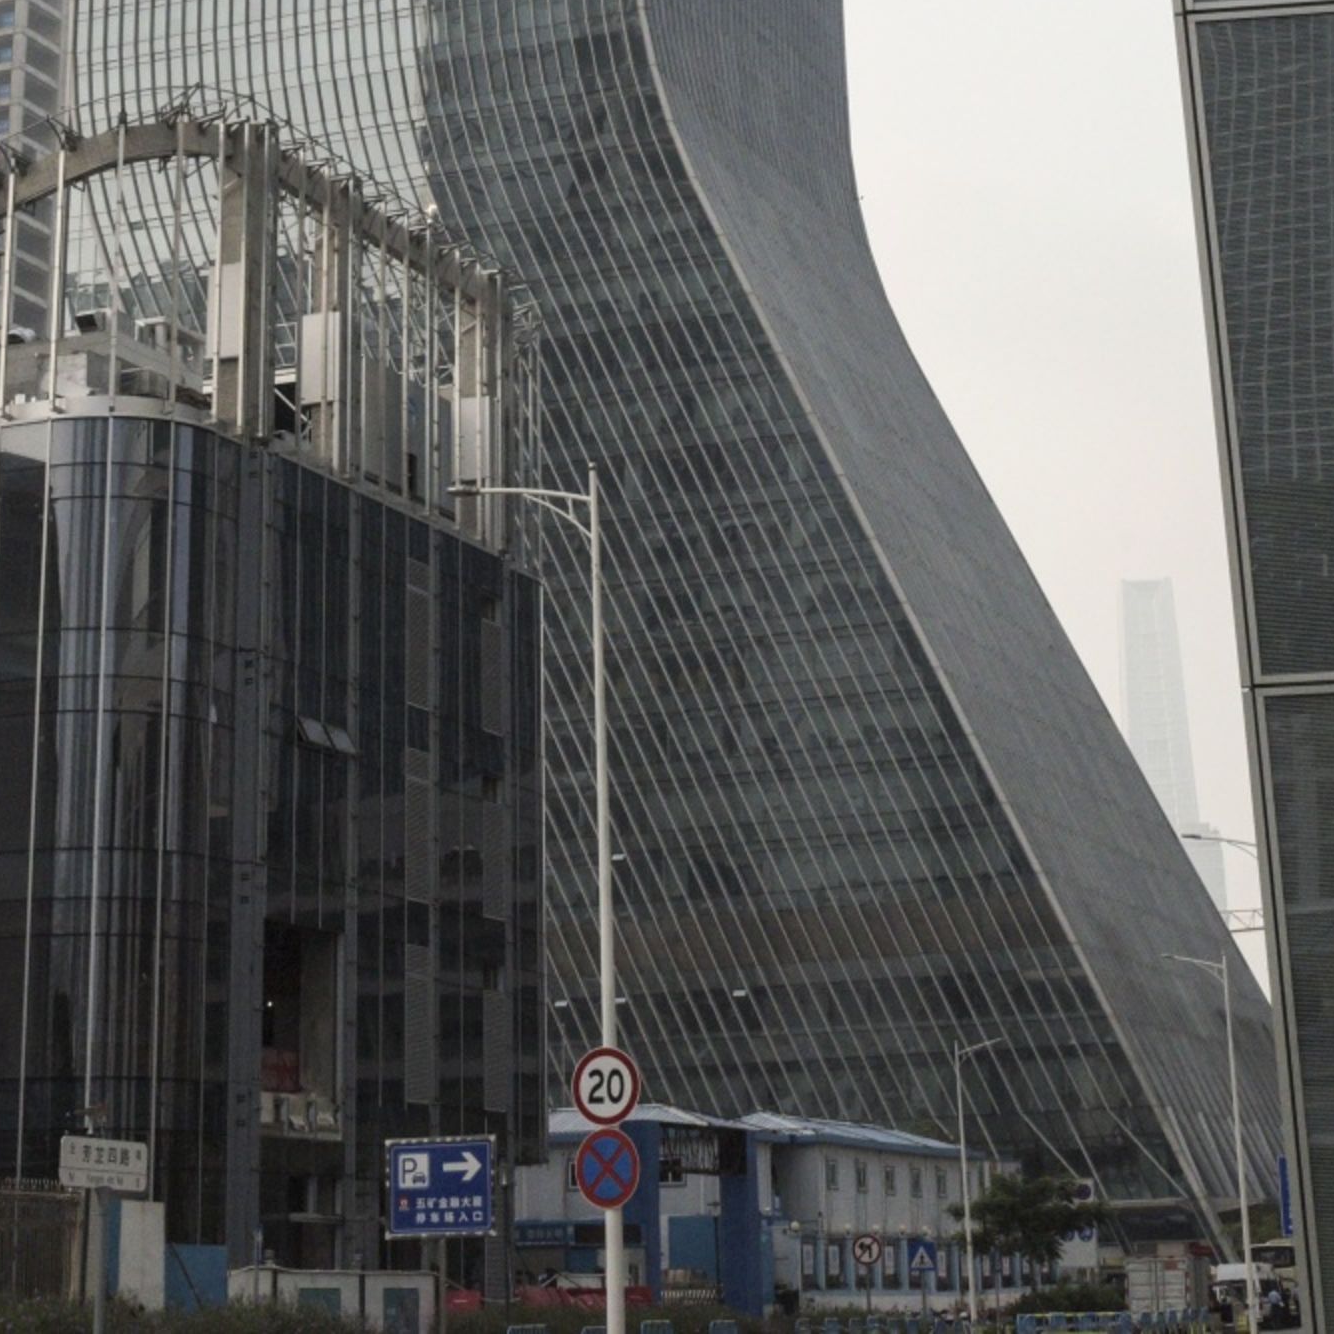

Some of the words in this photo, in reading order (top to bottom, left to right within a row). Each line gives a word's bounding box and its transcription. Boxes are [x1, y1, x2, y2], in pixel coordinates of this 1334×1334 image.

[588, 1068, 624, 1104] 20
[402, 1157, 418, 1185] P
[416, 1211, 484, 1224] 停车场入口
